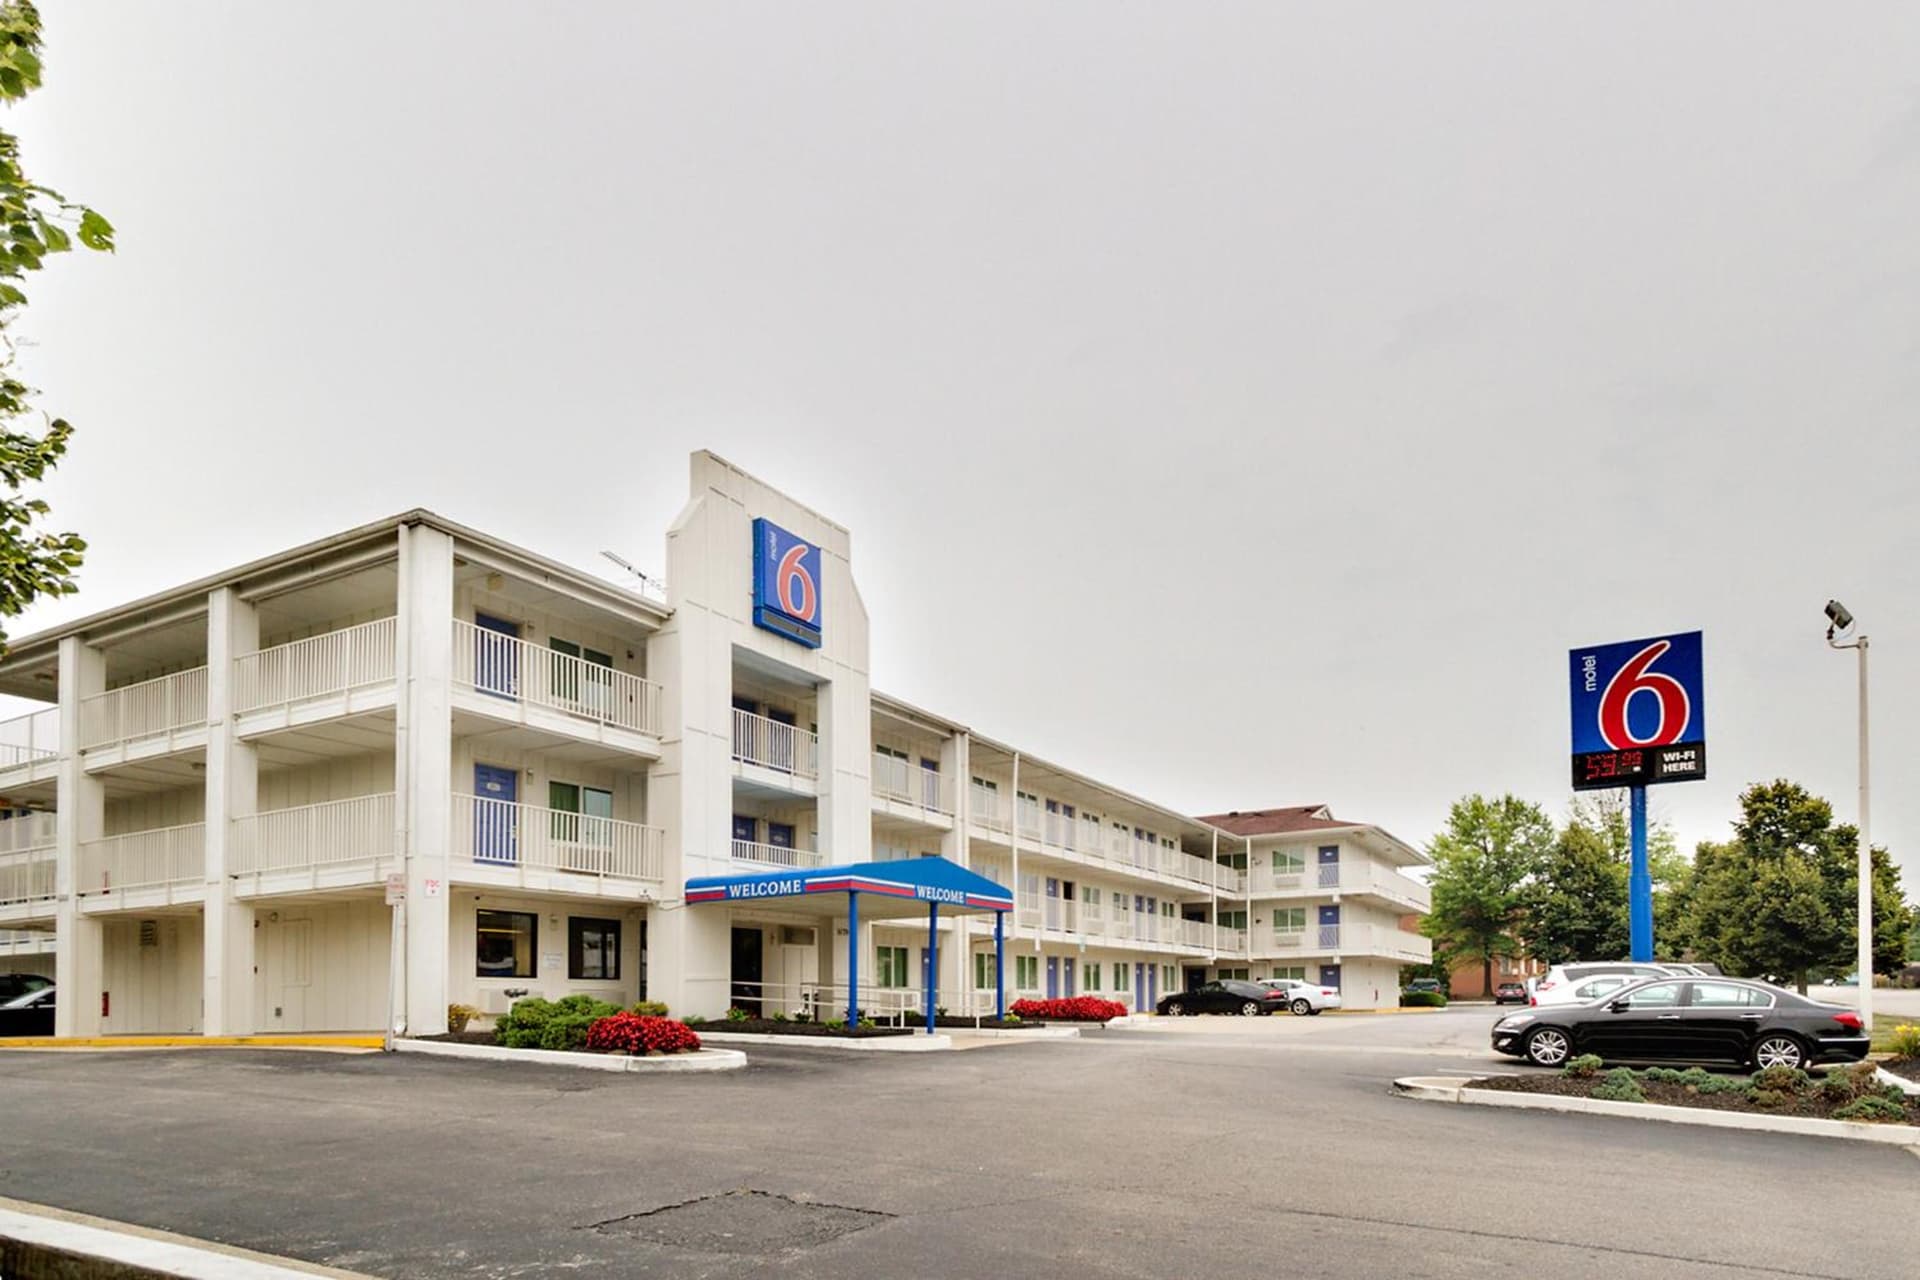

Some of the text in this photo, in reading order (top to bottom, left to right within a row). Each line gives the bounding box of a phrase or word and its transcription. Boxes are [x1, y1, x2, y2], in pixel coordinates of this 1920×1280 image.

[777, 544, 816, 622] 6
[1582, 640, 1690, 750] motel 6
[1662, 750, 1696, 762] WI-FI
[1662, 761, 1697, 773] HERE
[729, 879, 802, 898] WELCOME
[916, 885, 965, 904] WELCOME
